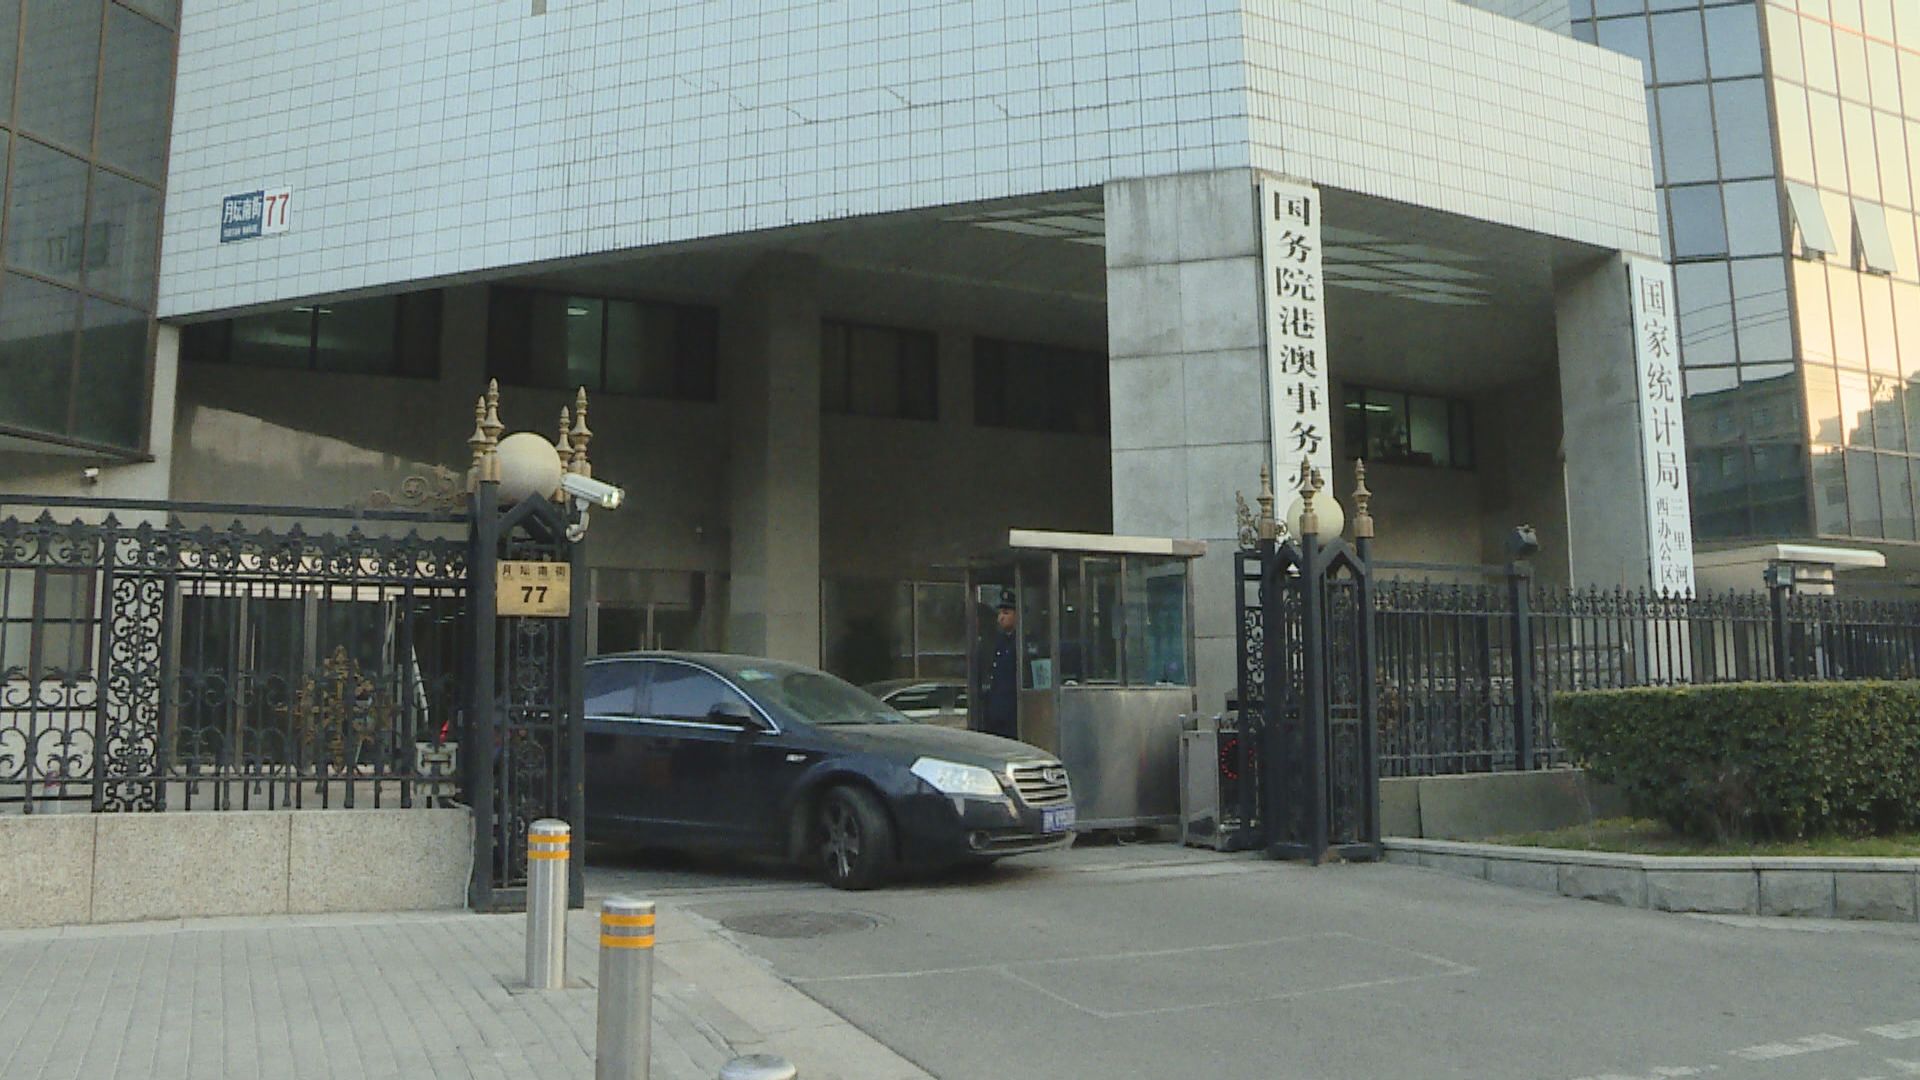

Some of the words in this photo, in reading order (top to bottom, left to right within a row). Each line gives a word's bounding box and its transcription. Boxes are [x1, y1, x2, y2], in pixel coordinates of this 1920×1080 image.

[223, 196, 262, 223] 月坛南街
[266, 193, 289, 227] 77
[1640, 276, 1679, 490] 国家统计局
[521, 586, 548, 603] 77
